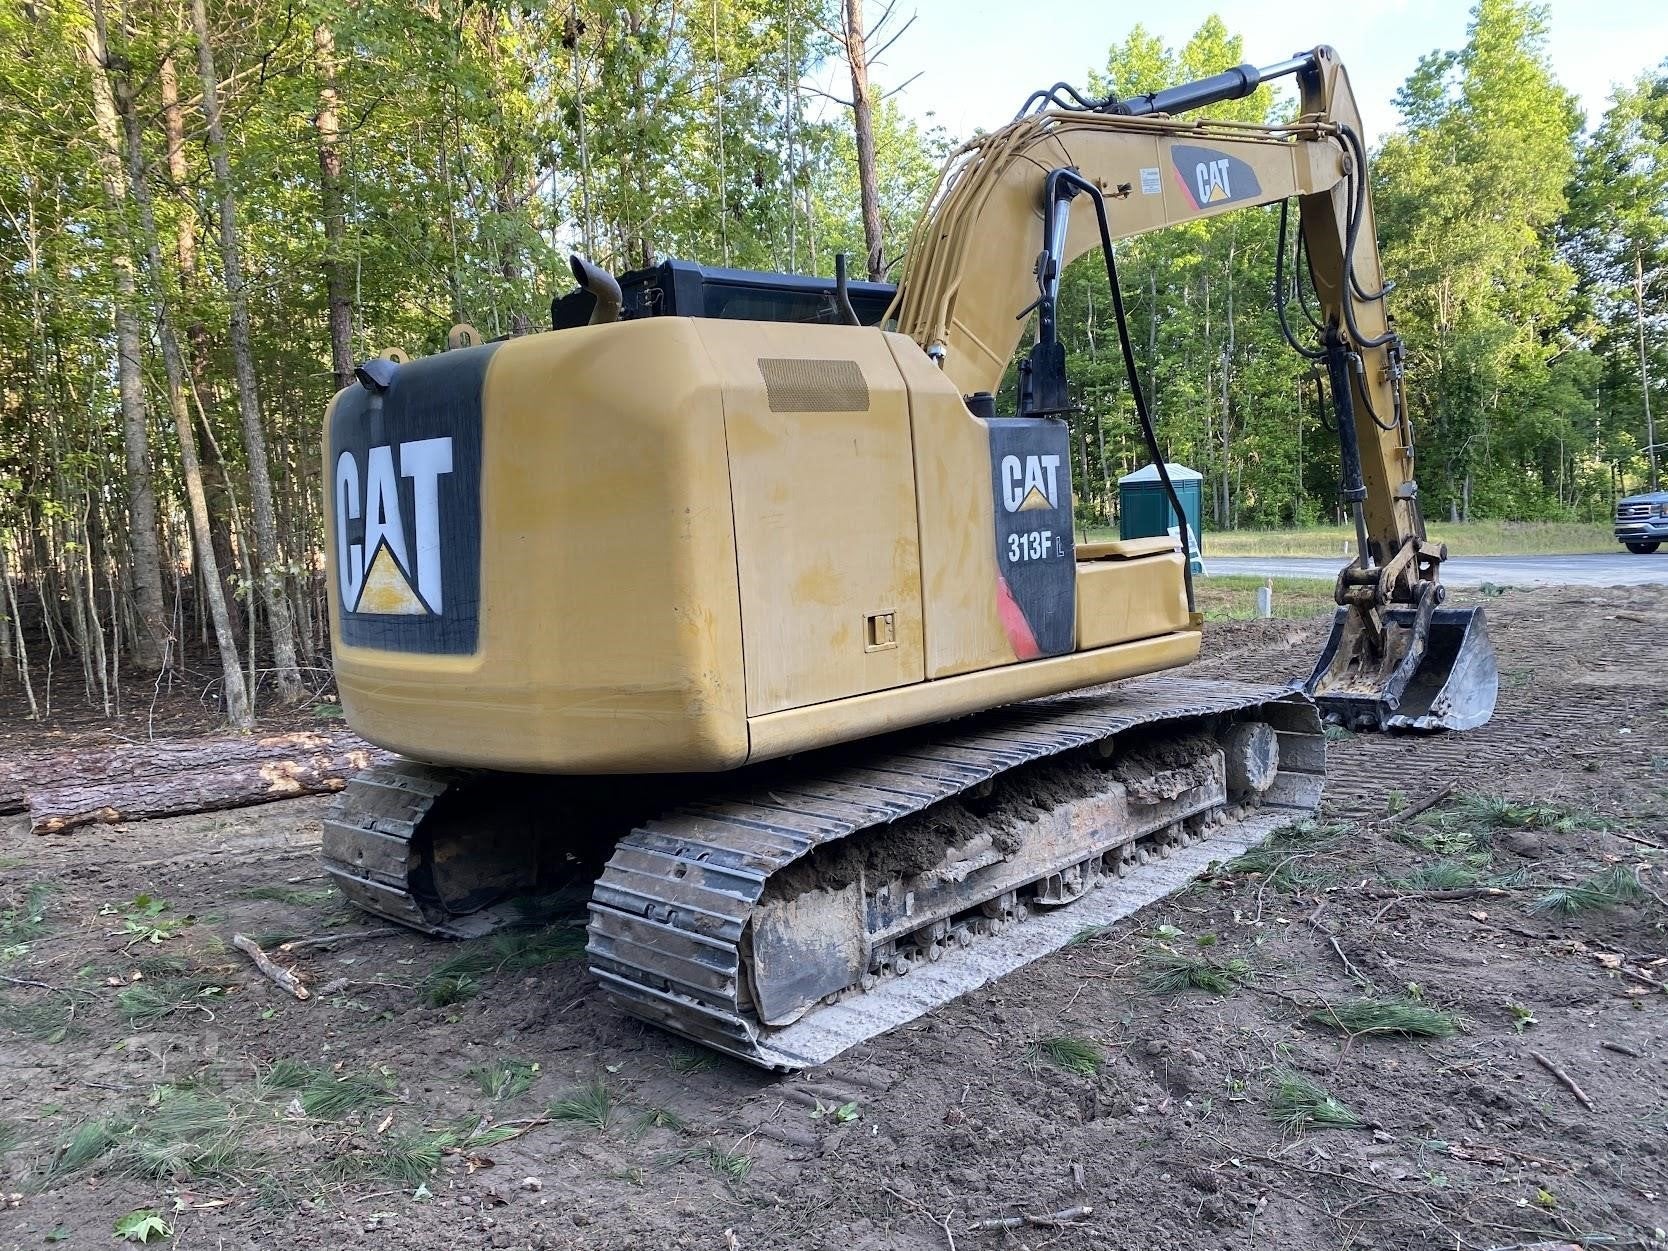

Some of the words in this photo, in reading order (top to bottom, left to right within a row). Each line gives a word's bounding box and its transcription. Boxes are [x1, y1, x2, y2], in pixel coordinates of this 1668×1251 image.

[1196, 159, 1231, 204] CAT
[1001, 454, 1060, 513] CAT
[337, 437, 453, 616] CAT
[1008, 531, 1052, 563] 313F
[1055, 536, 1065, 558] L
